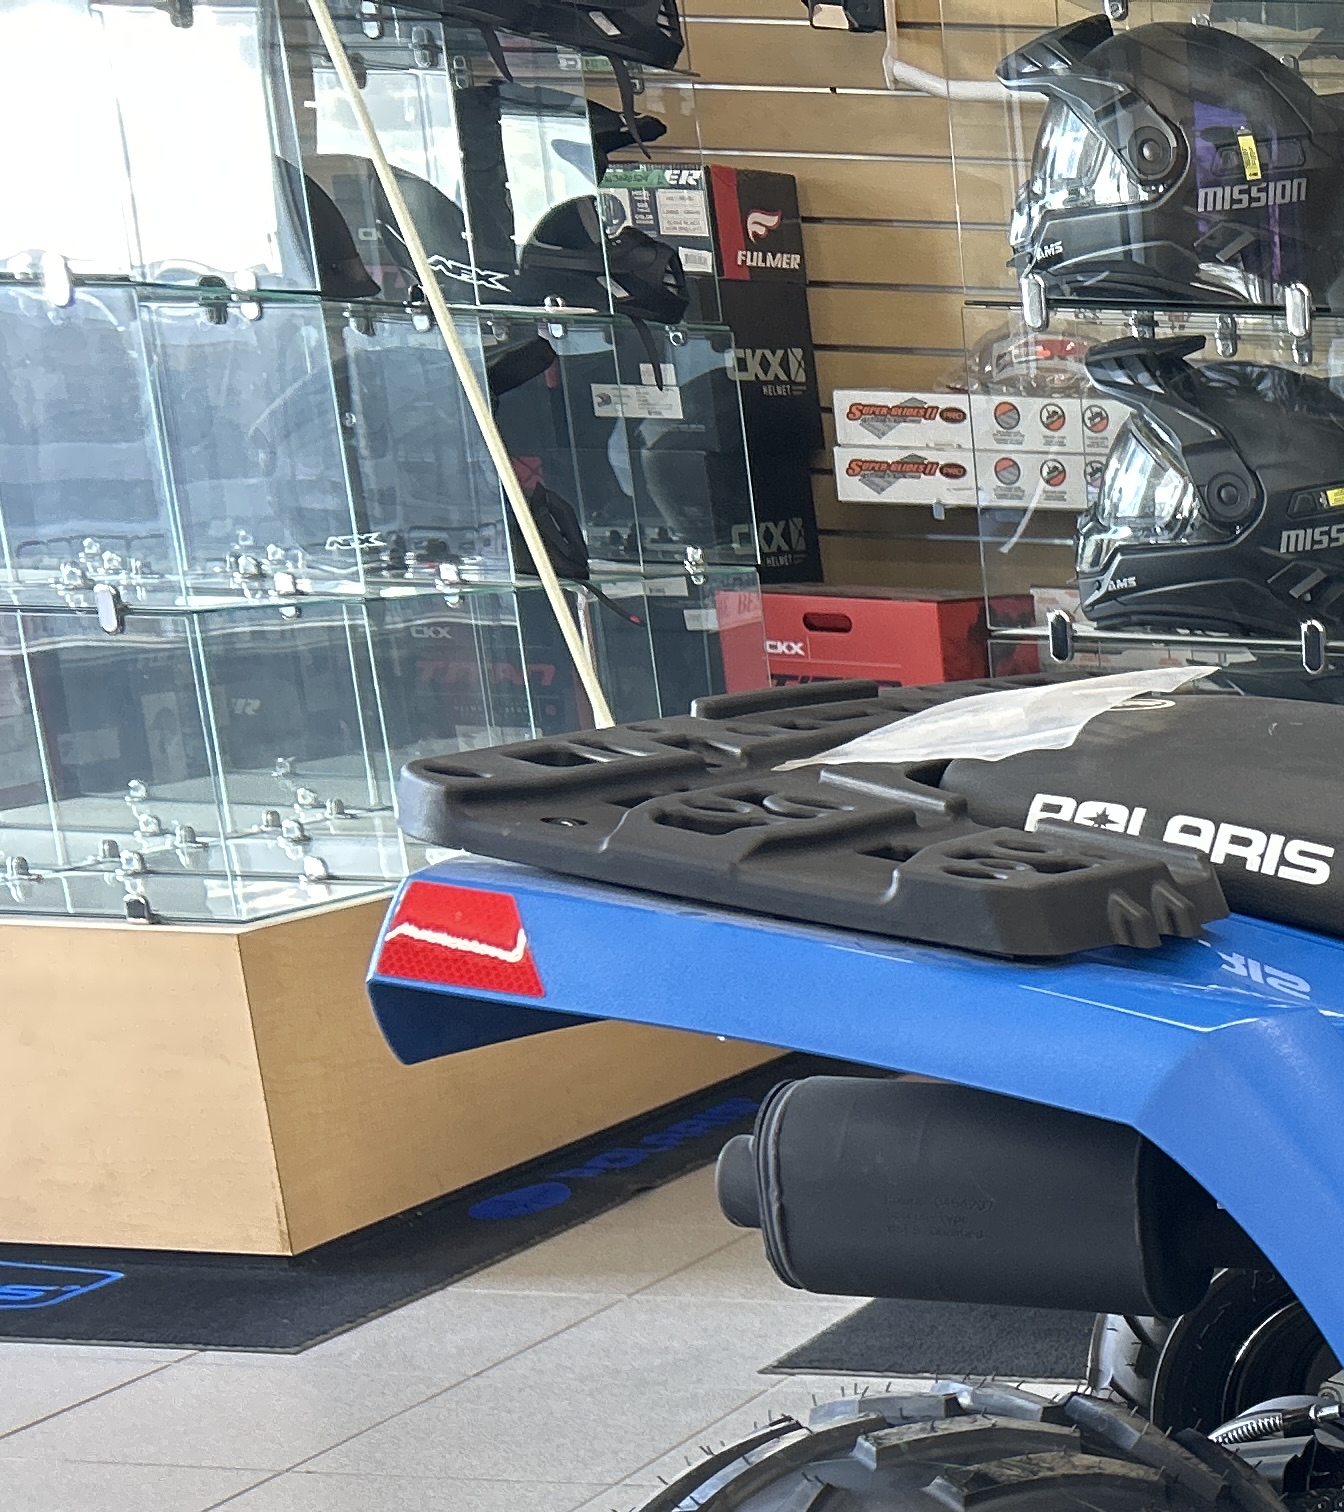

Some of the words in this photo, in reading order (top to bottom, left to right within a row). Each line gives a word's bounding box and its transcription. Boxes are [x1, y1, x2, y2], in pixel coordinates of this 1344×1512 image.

[1198, 177, 1308, 212] MISSION
[737, 250, 801, 270] FULMER
[725, 348, 783, 382] CKX
[766, 640, 805, 656] CKX
